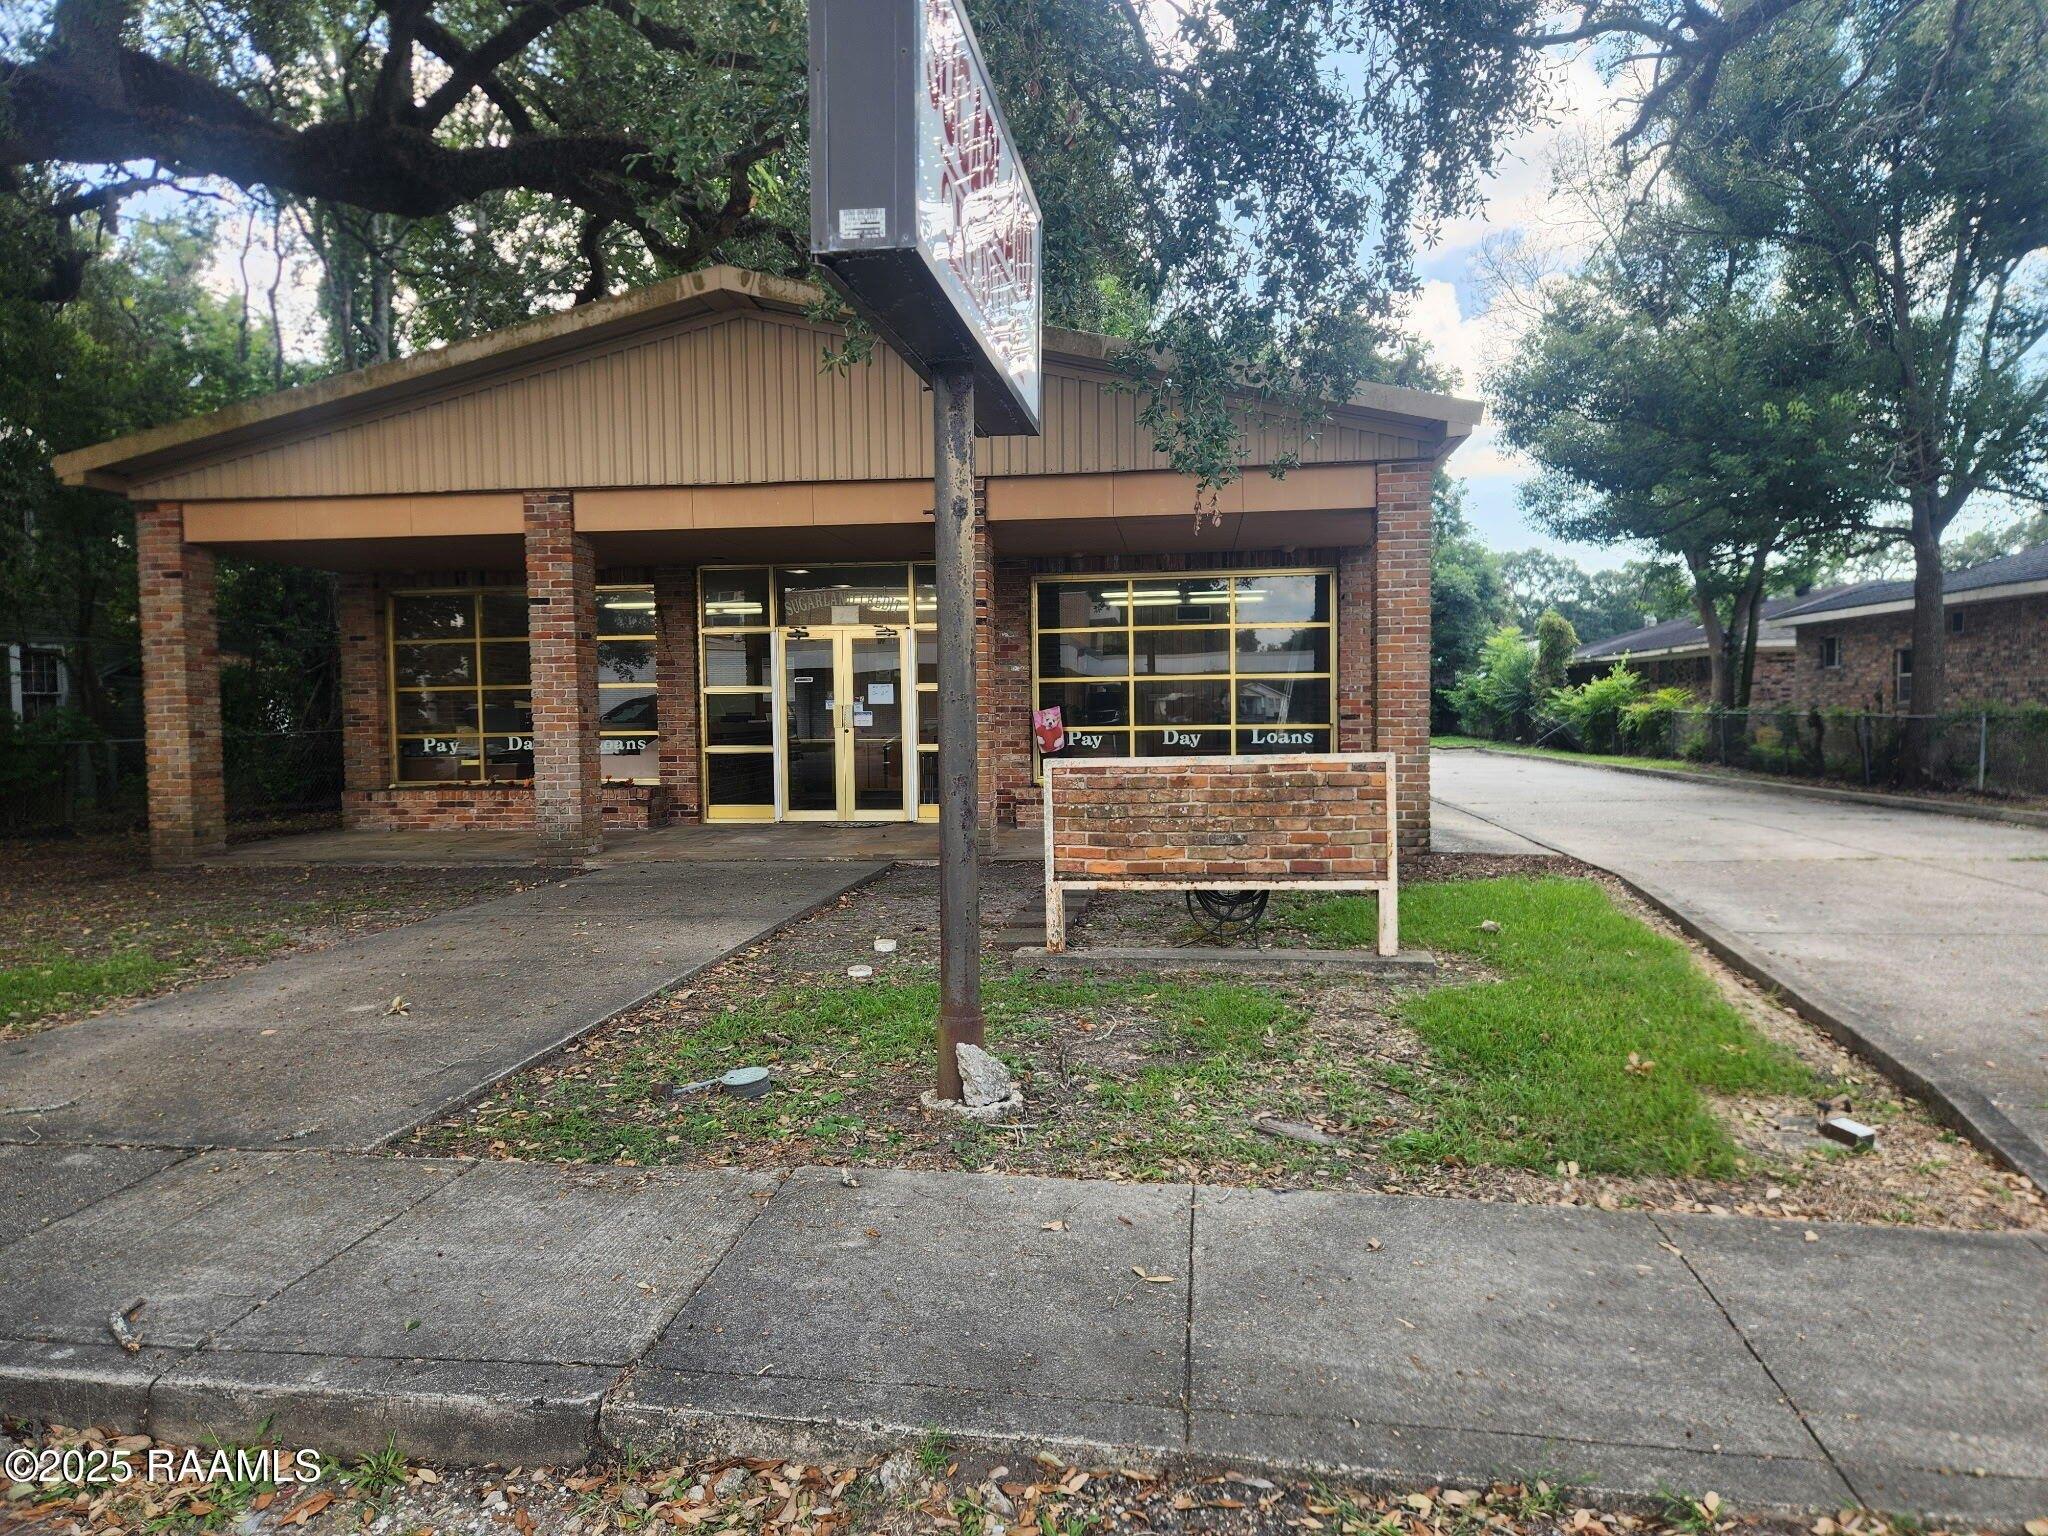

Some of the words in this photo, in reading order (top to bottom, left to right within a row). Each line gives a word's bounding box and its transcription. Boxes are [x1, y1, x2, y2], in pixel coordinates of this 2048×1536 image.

[423, 737, 460, 754] Pay
[508, 736, 534, 751] Da
[600, 738, 647, 751] oans
[1067, 731, 1103, 748] Pay
[1162, 729, 1202, 748] Day
[1251, 729, 1314, 745] Loans
